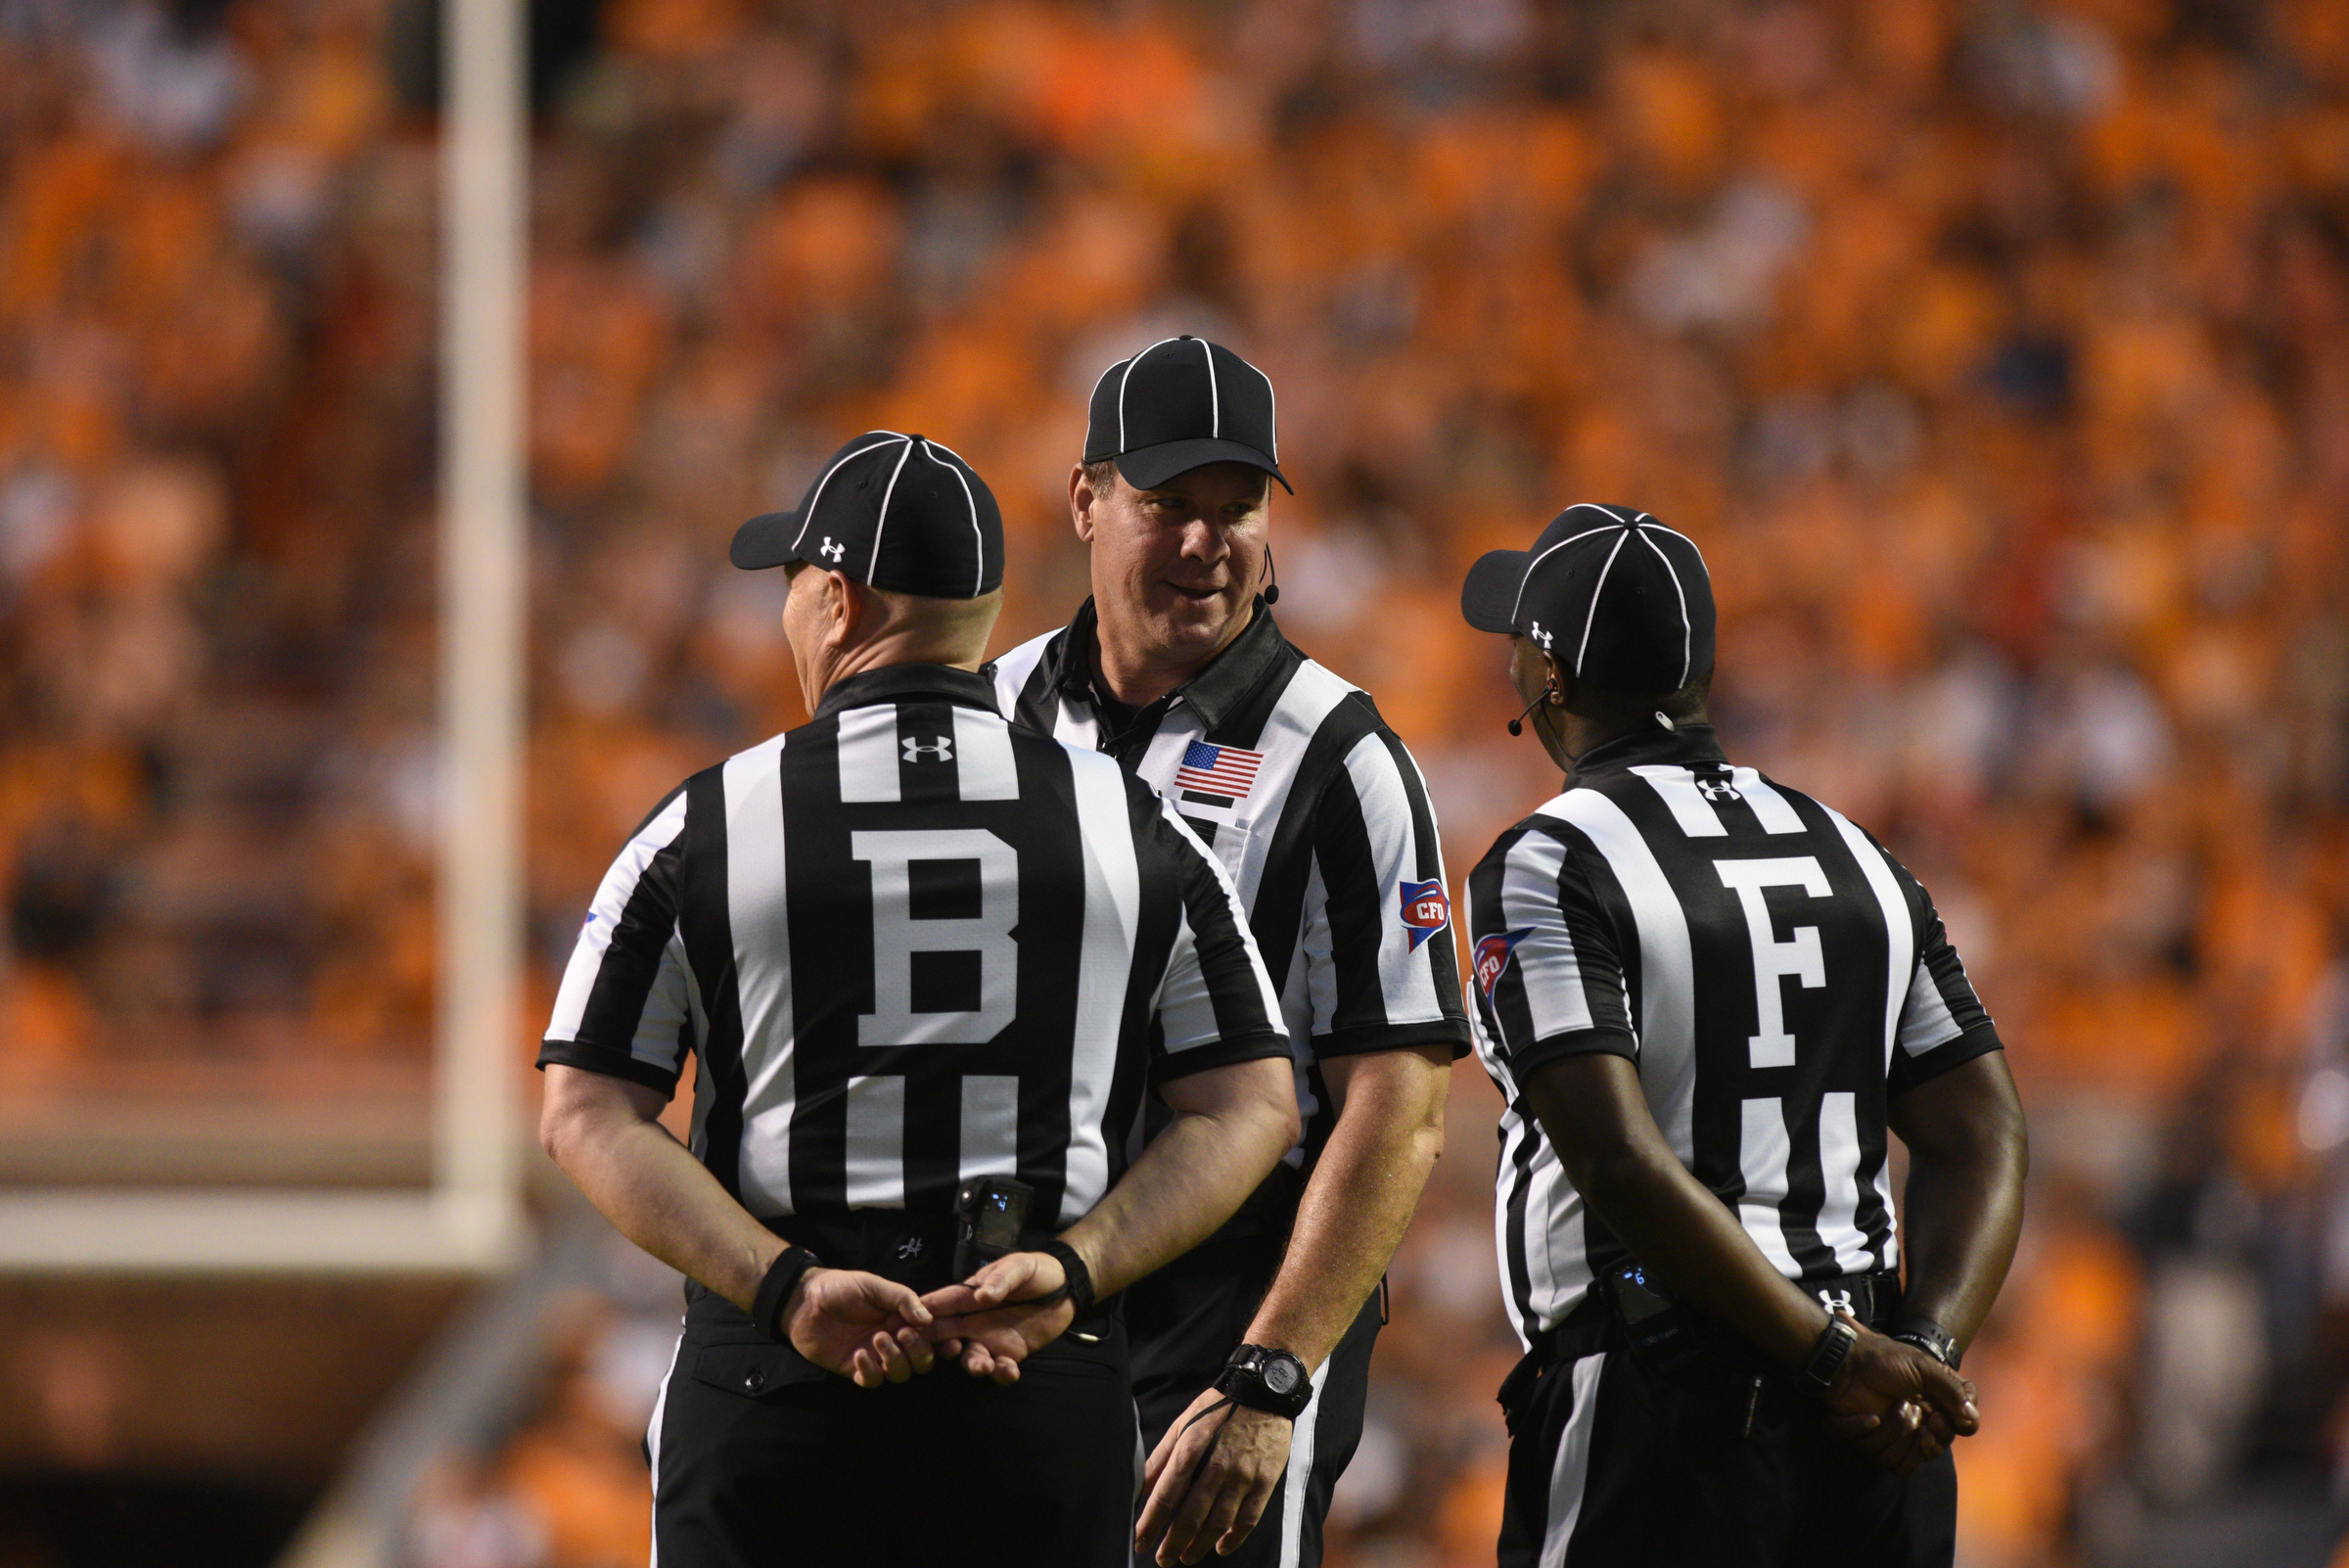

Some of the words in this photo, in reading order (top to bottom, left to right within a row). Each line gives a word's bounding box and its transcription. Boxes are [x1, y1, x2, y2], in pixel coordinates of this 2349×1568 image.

[1416, 901, 1445, 921] CFO
[852, 829, 1018, 1046] B
[1479, 955, 1500, 988] CFO
[1712, 855, 1833, 1069] F
[1635, 1272, 1645, 1285] 6
